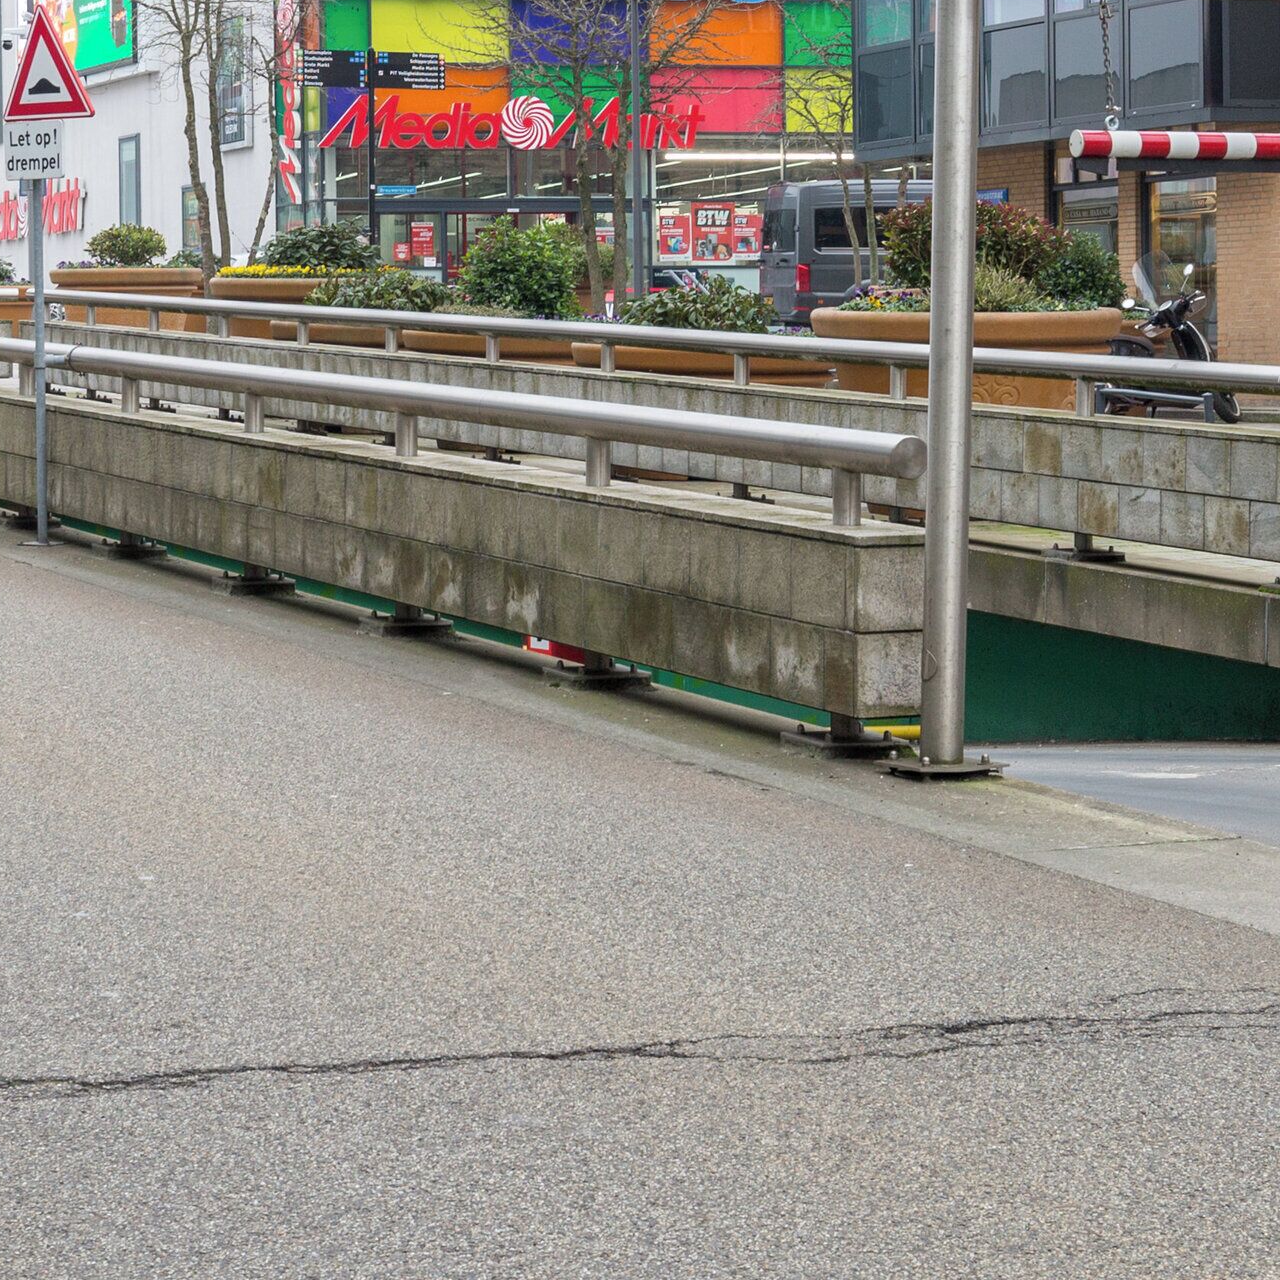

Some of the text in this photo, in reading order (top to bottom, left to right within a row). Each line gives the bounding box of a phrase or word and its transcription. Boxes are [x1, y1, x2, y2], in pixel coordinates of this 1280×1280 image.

[318, 94, 501, 150] Media
[9, 128, 57, 149] Let op!
[7, 153, 60, 173] drempel
[697, 209, 730, 226] BTW
